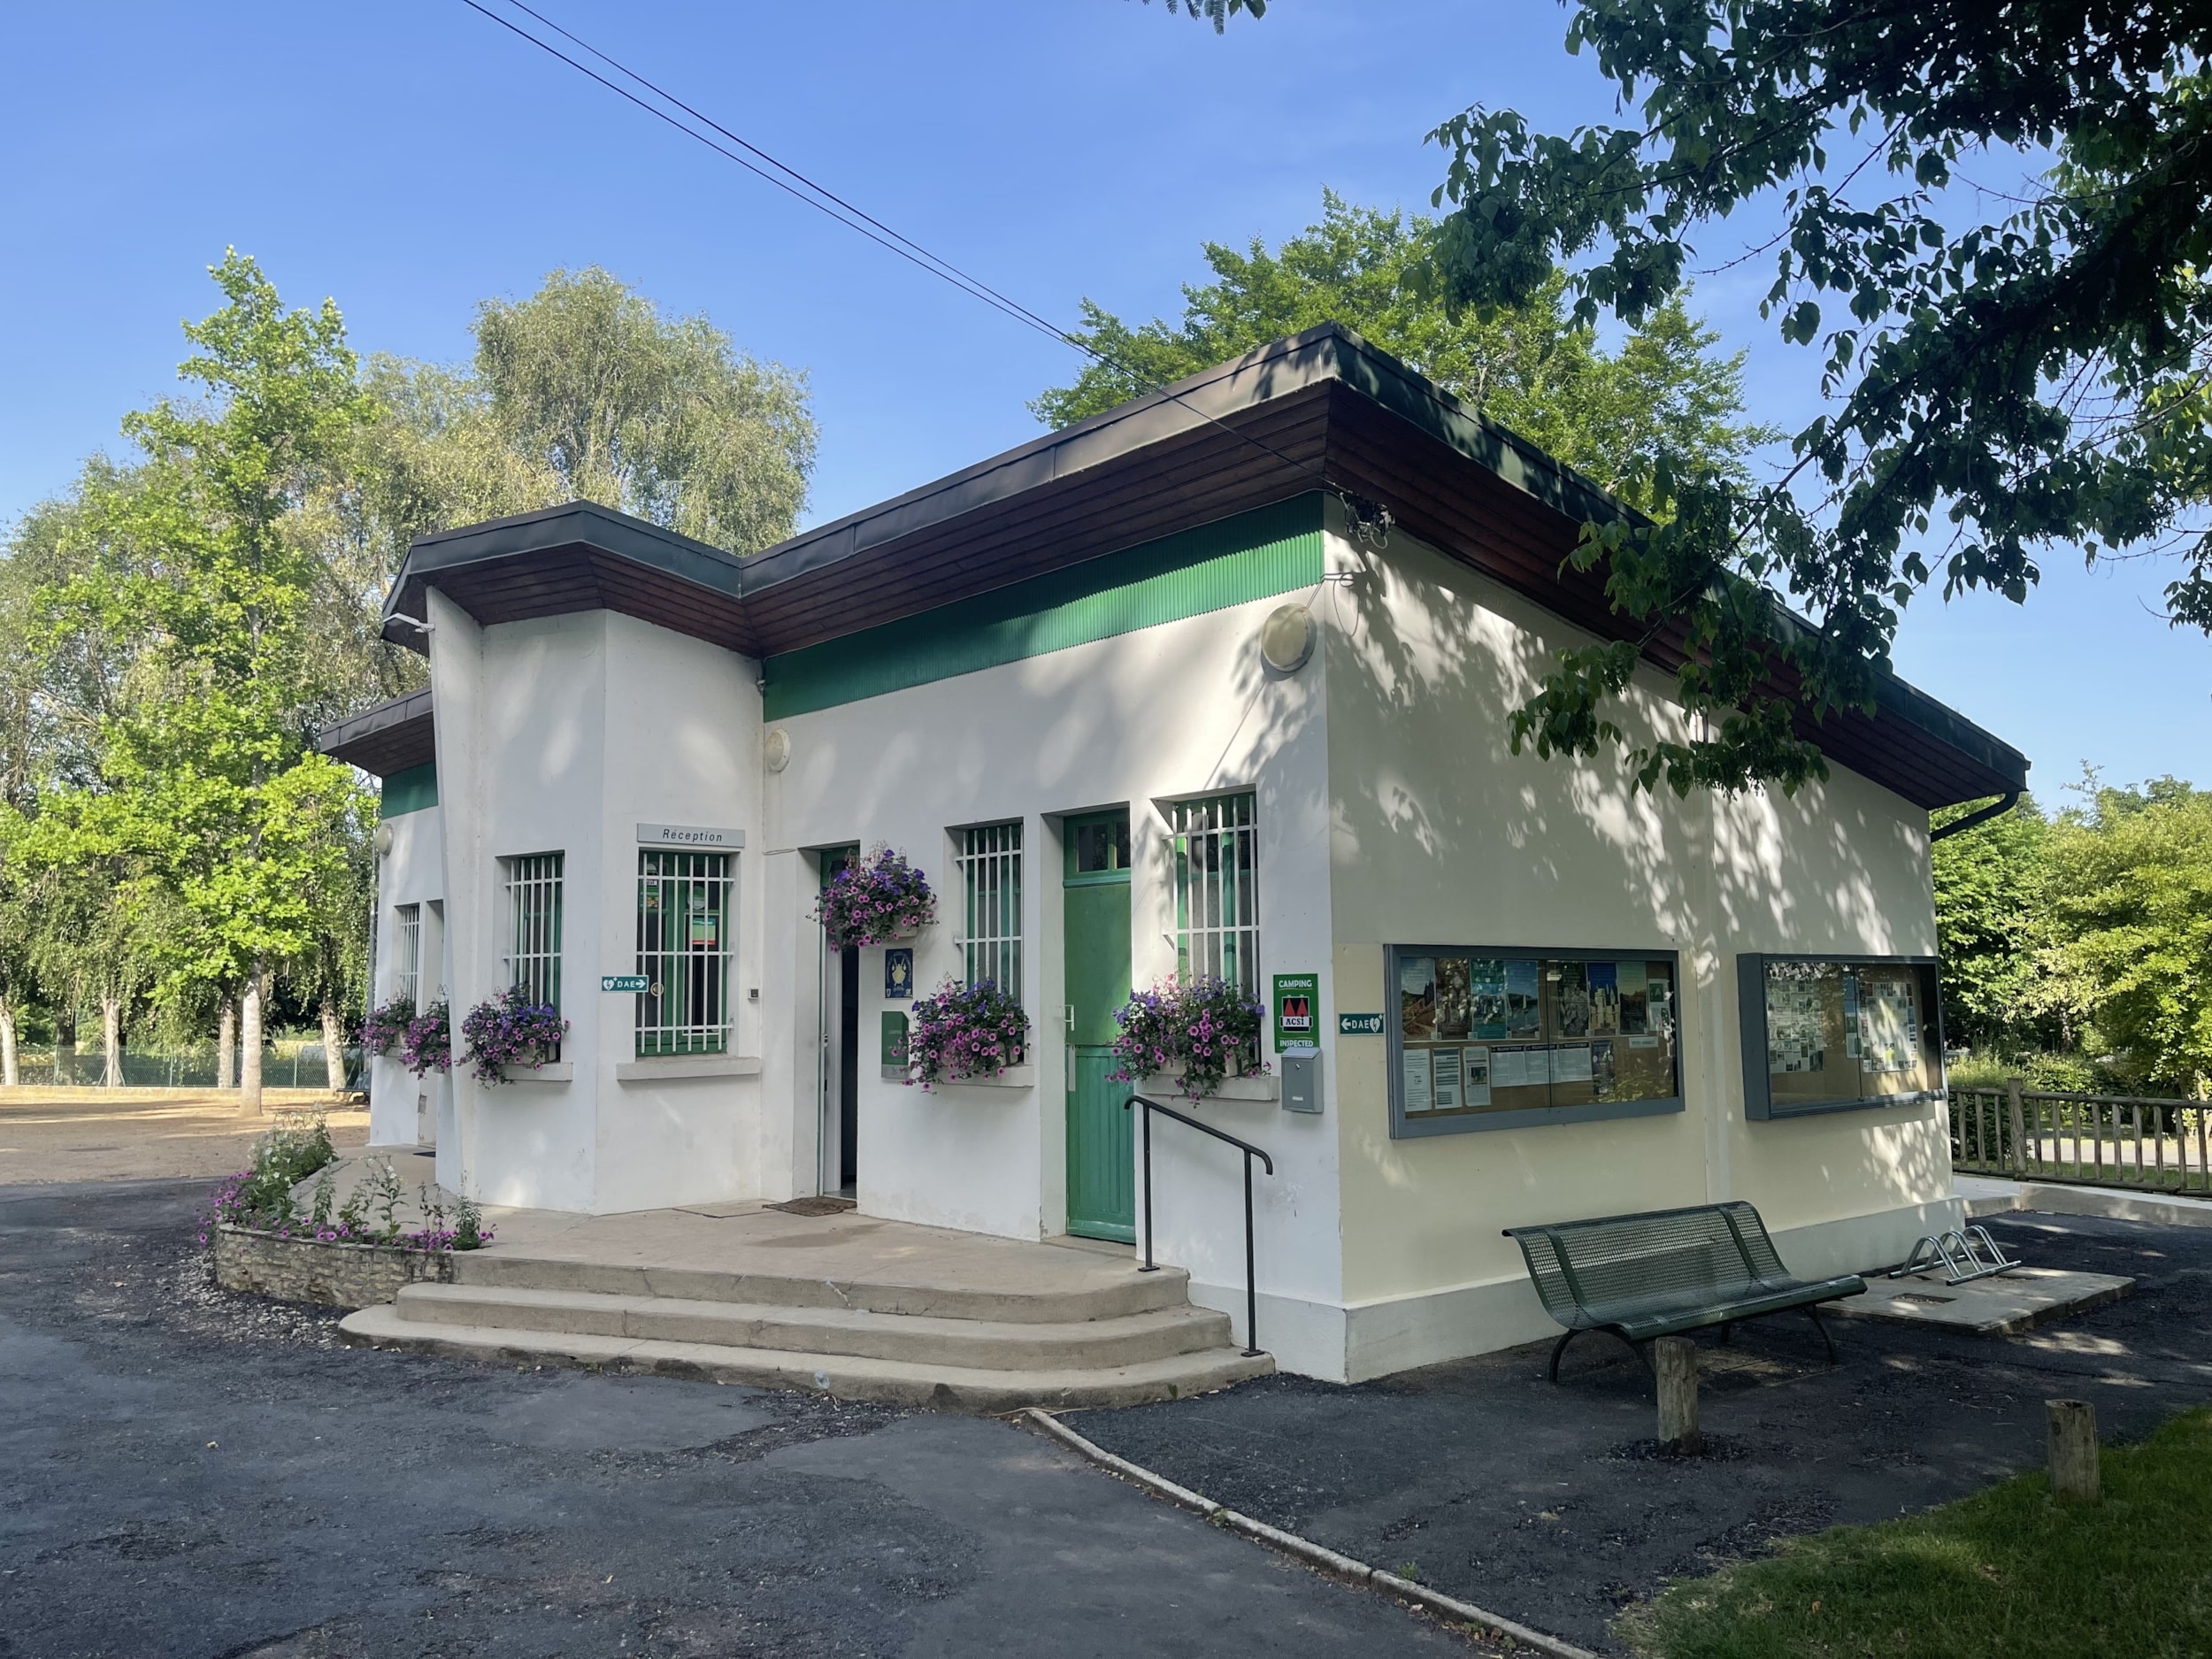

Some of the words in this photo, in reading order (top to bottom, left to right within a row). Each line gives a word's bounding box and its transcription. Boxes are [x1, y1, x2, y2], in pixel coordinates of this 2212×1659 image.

[663, 828, 723, 843] Réception
[1279, 979, 1313, 988] CAMPING
[1351, 1019, 1370, 1029] DAE
[1279, 1039, 1314, 1048] INSPECTED
